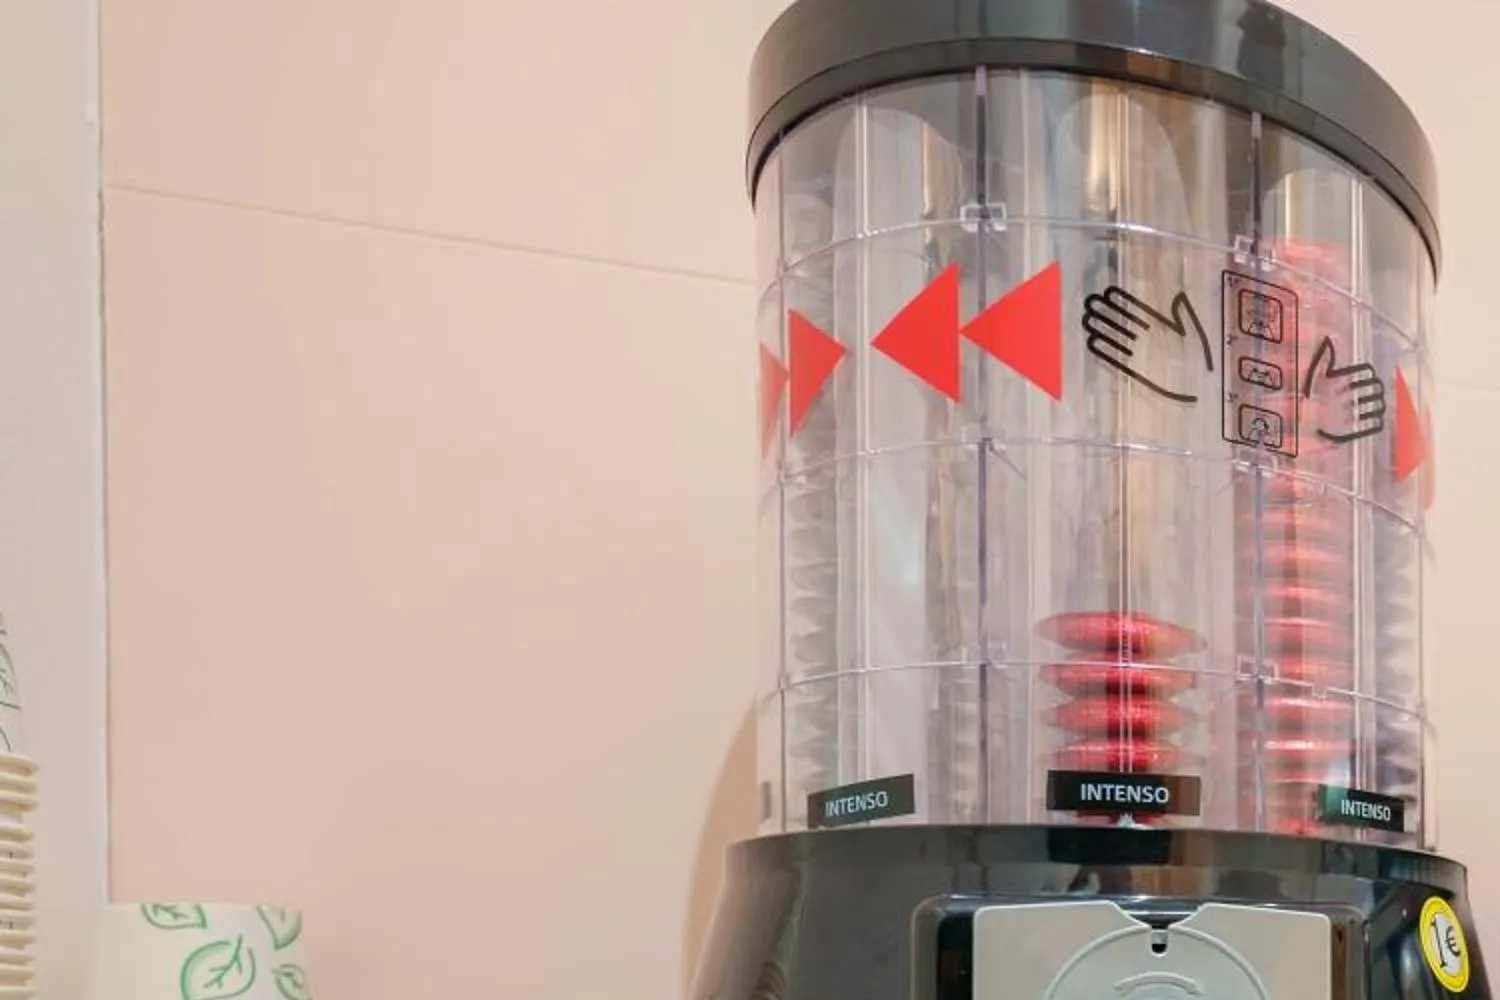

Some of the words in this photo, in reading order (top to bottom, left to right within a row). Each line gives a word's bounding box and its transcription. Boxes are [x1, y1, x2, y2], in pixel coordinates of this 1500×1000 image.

[825, 791, 888, 817] INTENSO
[1081, 783, 1170, 803] INTENSO
[1341, 799, 1391, 821] INTENSO
[1430, 919, 1461, 968] 1€
